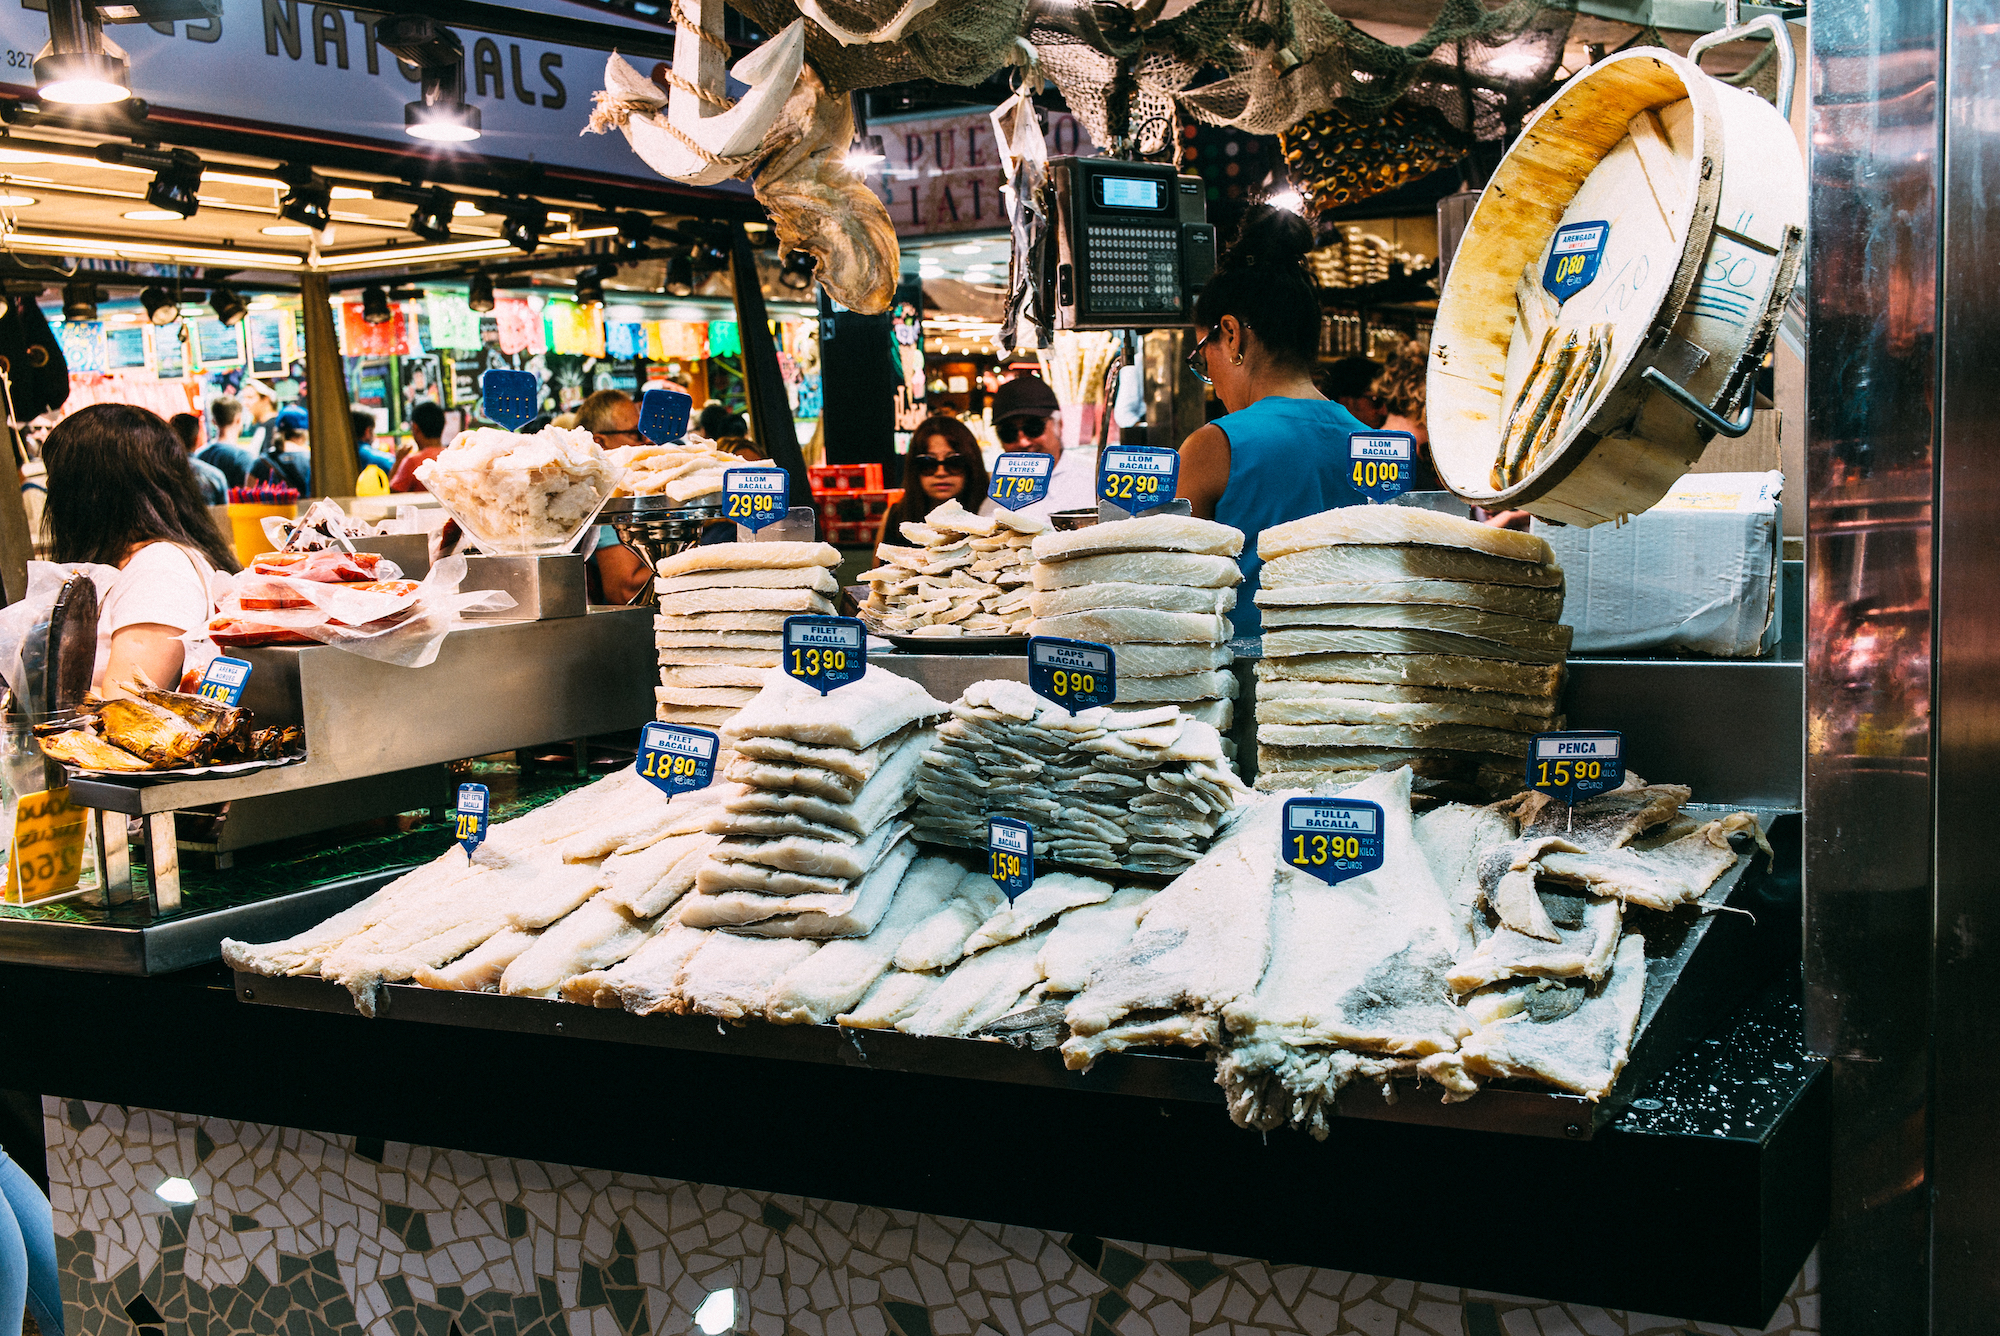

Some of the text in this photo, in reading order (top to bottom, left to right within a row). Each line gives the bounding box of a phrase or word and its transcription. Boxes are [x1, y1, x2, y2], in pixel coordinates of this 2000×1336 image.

[262, 0, 568, 110] NATALS
[1562, 233, 1596, 243] ARENGADA
[1701, 249, 1757, 288] 30
[803, 635, 846, 643] BACALLA
[1057, 649, 1084, 659] CAPS
[1048, 656, 1094, 668] BACALLA
[668, 735, 693, 743] FILET
[658, 741, 699, 752] BACALLA
[1558, 743, 1596, 753] PENCA
[1315, 810, 1351, 819] FULLA
[1306, 819, 1359, 828] BACALLA
[1002, 830, 1016, 838] FILET
[999, 838, 1021, 848] BACALLA
